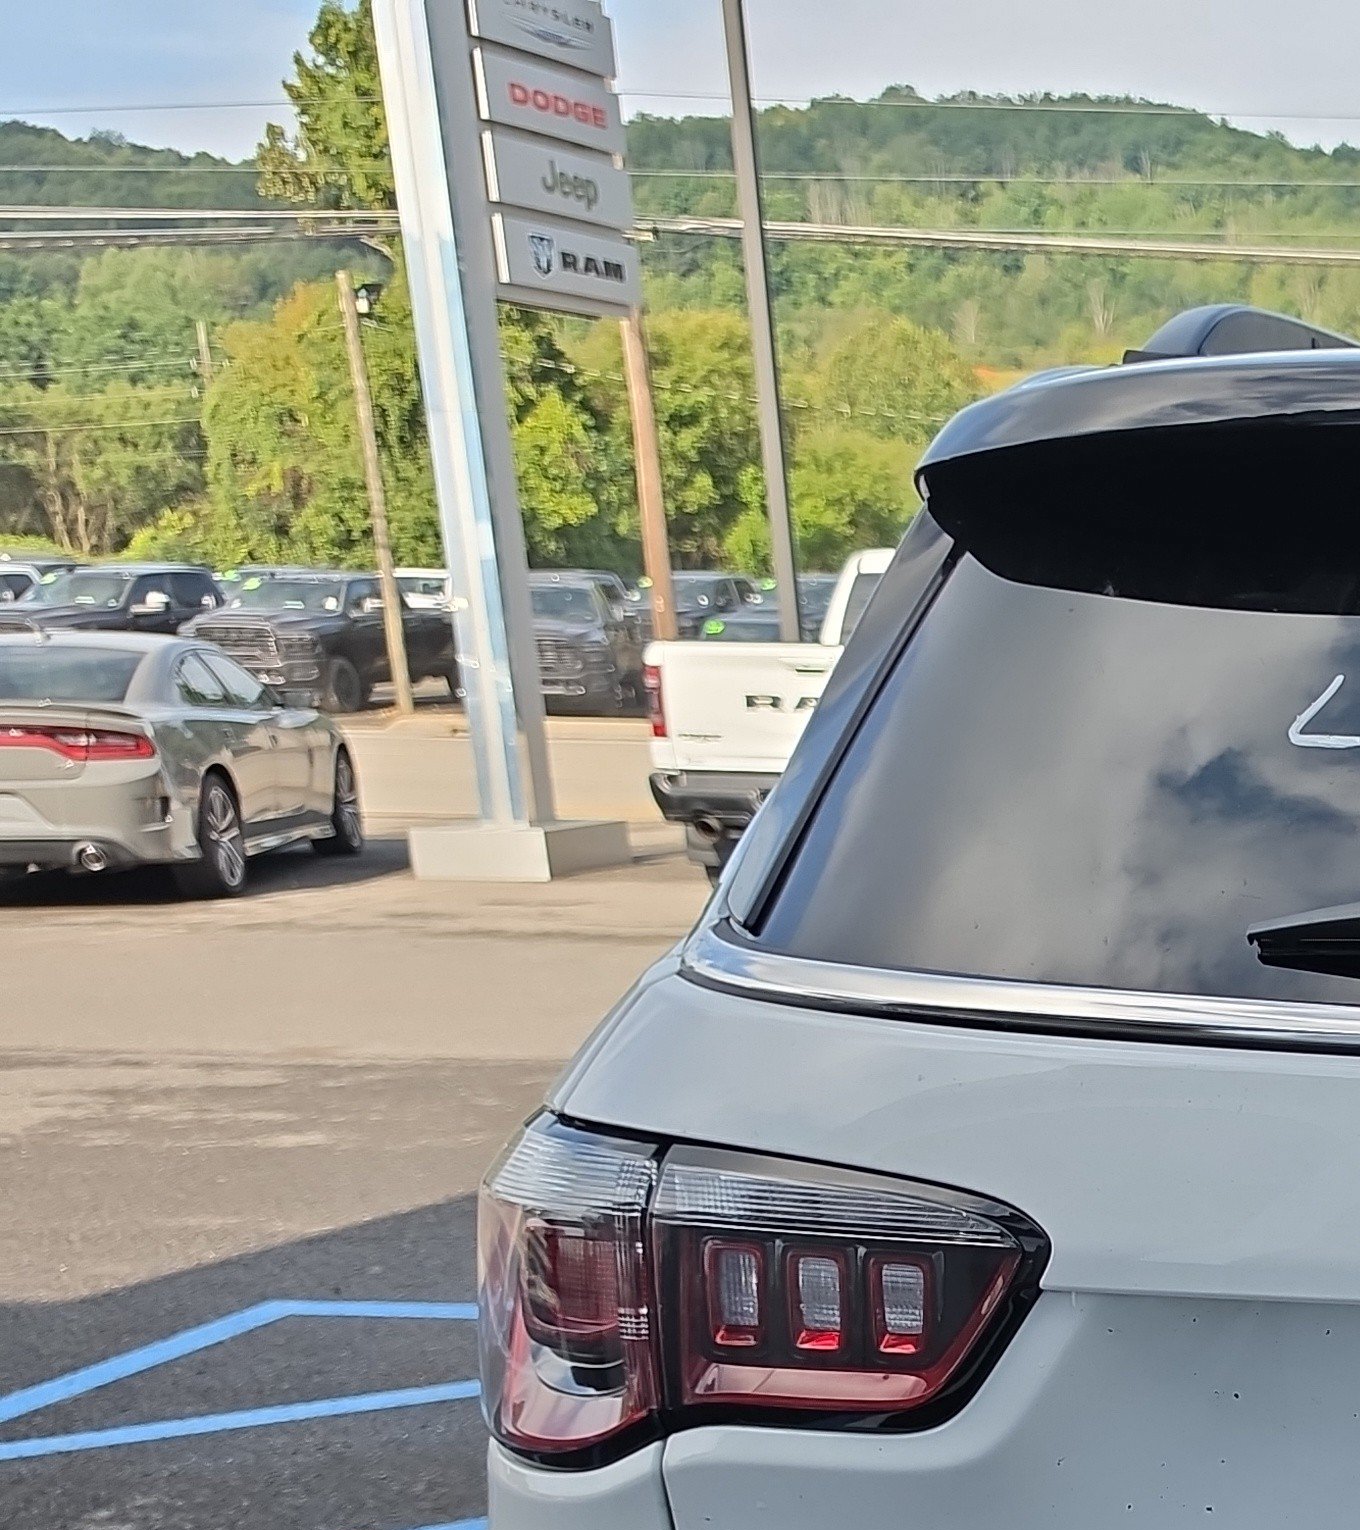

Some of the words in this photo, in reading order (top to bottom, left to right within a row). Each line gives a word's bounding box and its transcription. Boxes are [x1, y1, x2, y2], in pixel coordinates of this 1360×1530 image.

[507, 82, 608, 130] DODGE
[541, 159, 598, 212] Jeep
[560, 250, 625, 283] RAM
[745, 694, 819, 714] RA
